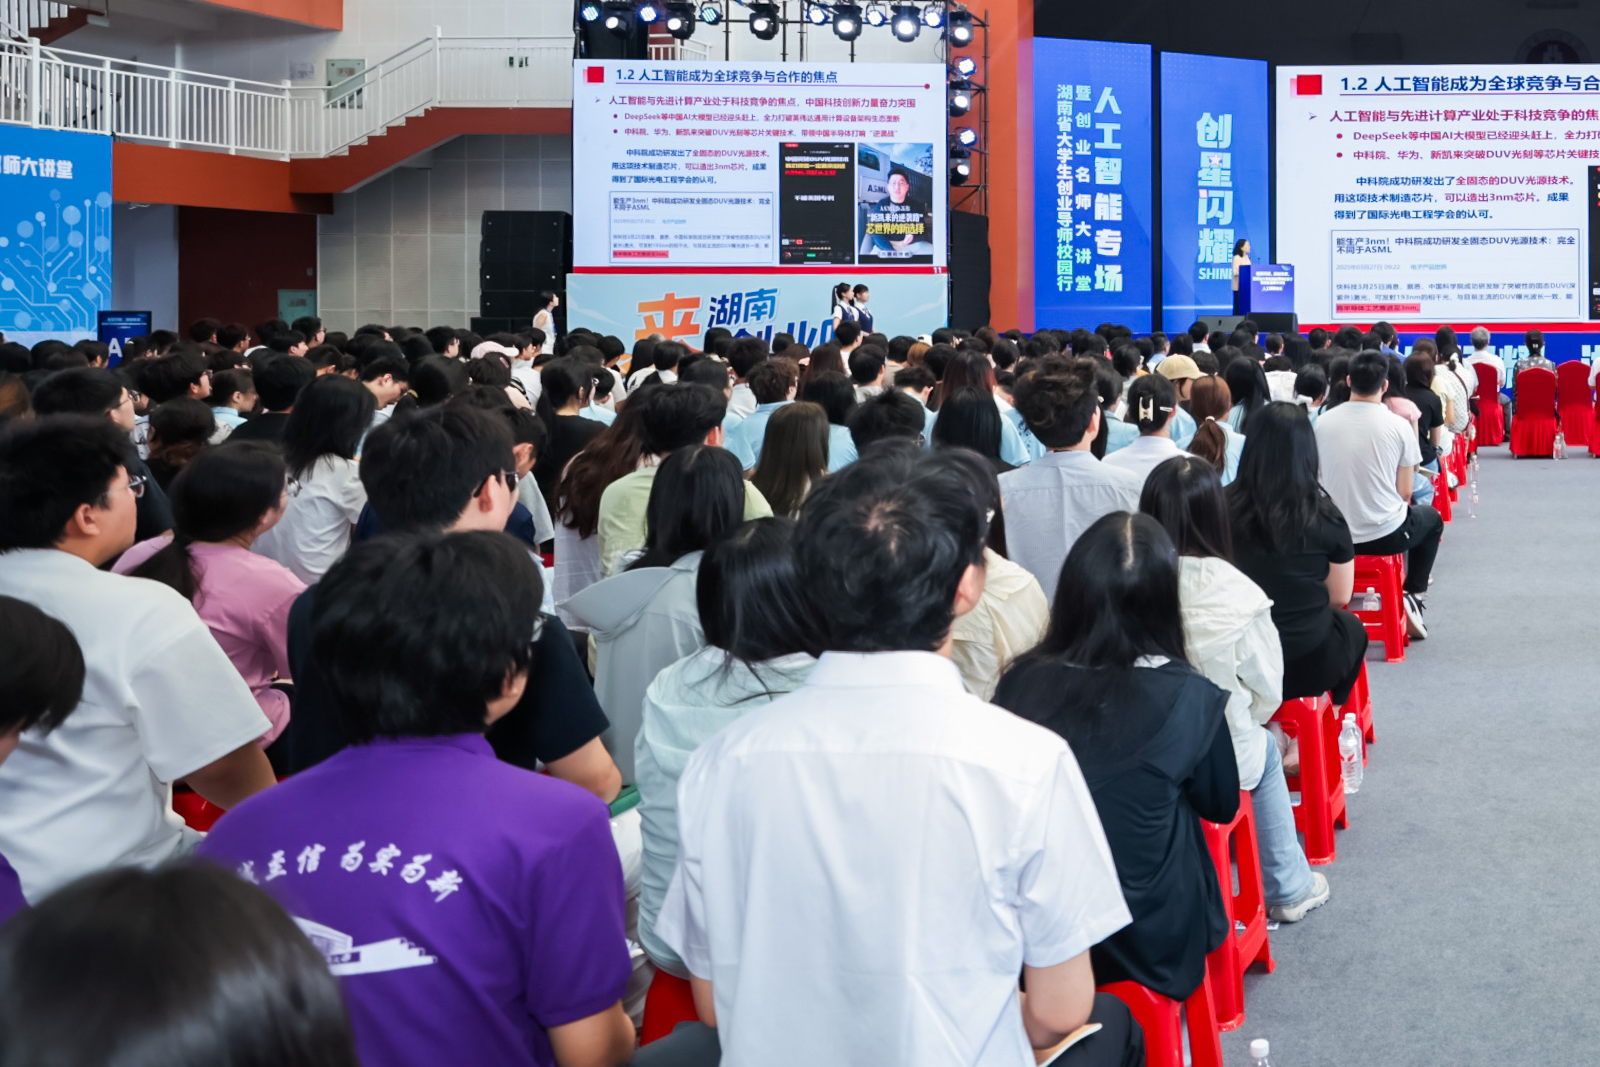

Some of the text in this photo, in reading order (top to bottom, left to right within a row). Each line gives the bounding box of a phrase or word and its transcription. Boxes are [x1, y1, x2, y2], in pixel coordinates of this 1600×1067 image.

[617, 69, 838, 83] 1.2 人工智能成为全球竞争与合作的焦点
[1340, 77, 1368, 91] 1.2
[0, 154, 73, 179] 师大讲堂
[1056, 84, 1073, 292] 湖南省大学生创业导师校园行
[1075, 84, 1092, 292] 暨创业名师大讲堂
[1094, 86, 1123, 292] 人工智能专场
[1196, 112, 1235, 264] 创星闪耀
[1334, 209, 1494, 220] 得到了国际光电工程学会的认可。
[1336, 246, 1393, 254] 不同于ASML
[706, 287, 779, 329] 湖南
